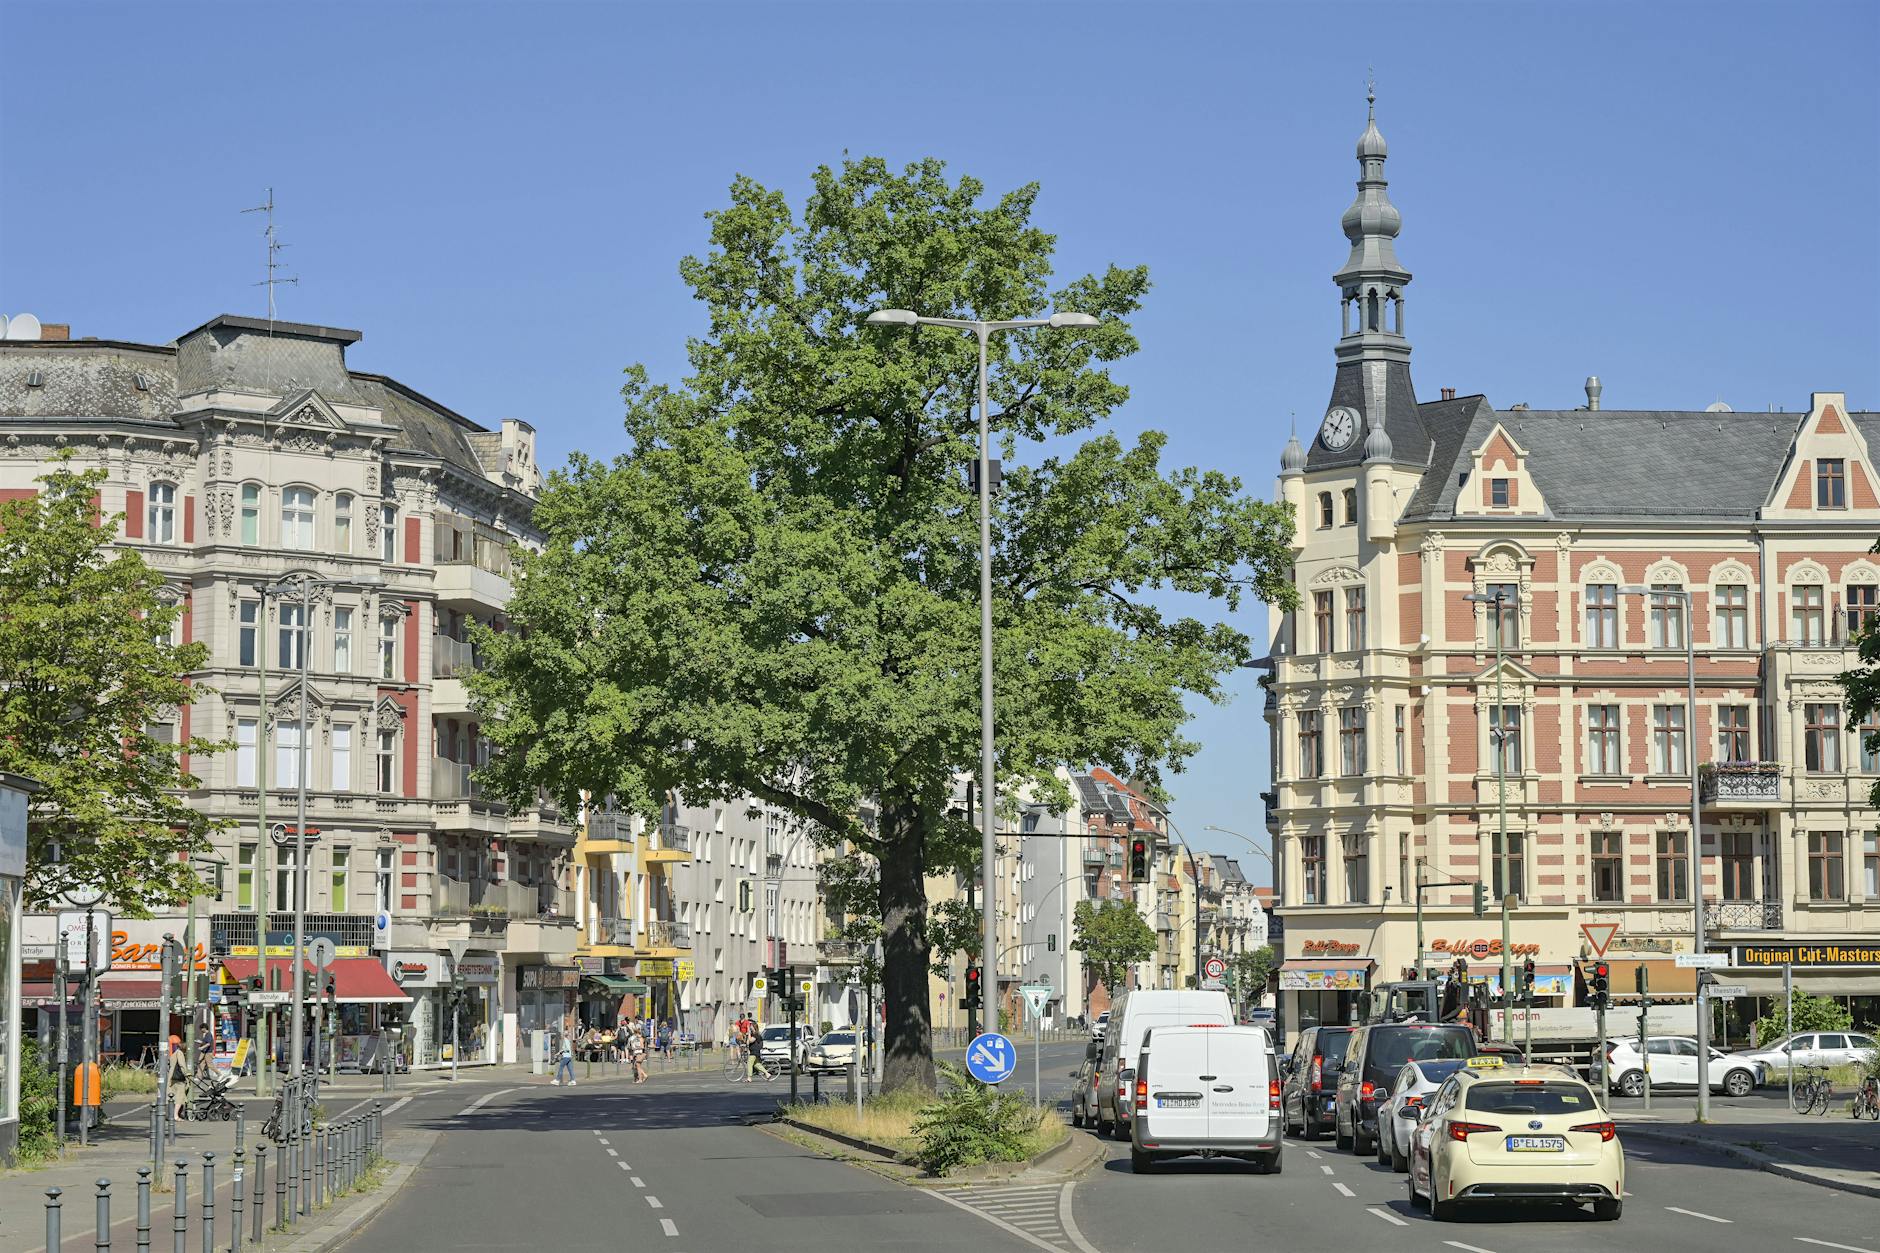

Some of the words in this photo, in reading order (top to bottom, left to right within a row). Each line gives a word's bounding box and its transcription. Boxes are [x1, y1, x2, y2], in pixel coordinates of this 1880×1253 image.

[22, 946, 43, 957] lstraße
[1489, 939, 1540, 957] Brger
[1745, 948, 1793, 964] Original
[1798, 946, 1880, 962] Cut-Masters
[1209, 964, 1221, 973] 30
[1496, 1011, 1541, 1022] Rndm
[1513, 1138, 1520, 1148] B
[1525, 1138, 1538, 1148] EL
[1540, 1138, 1563, 1149] 1575
